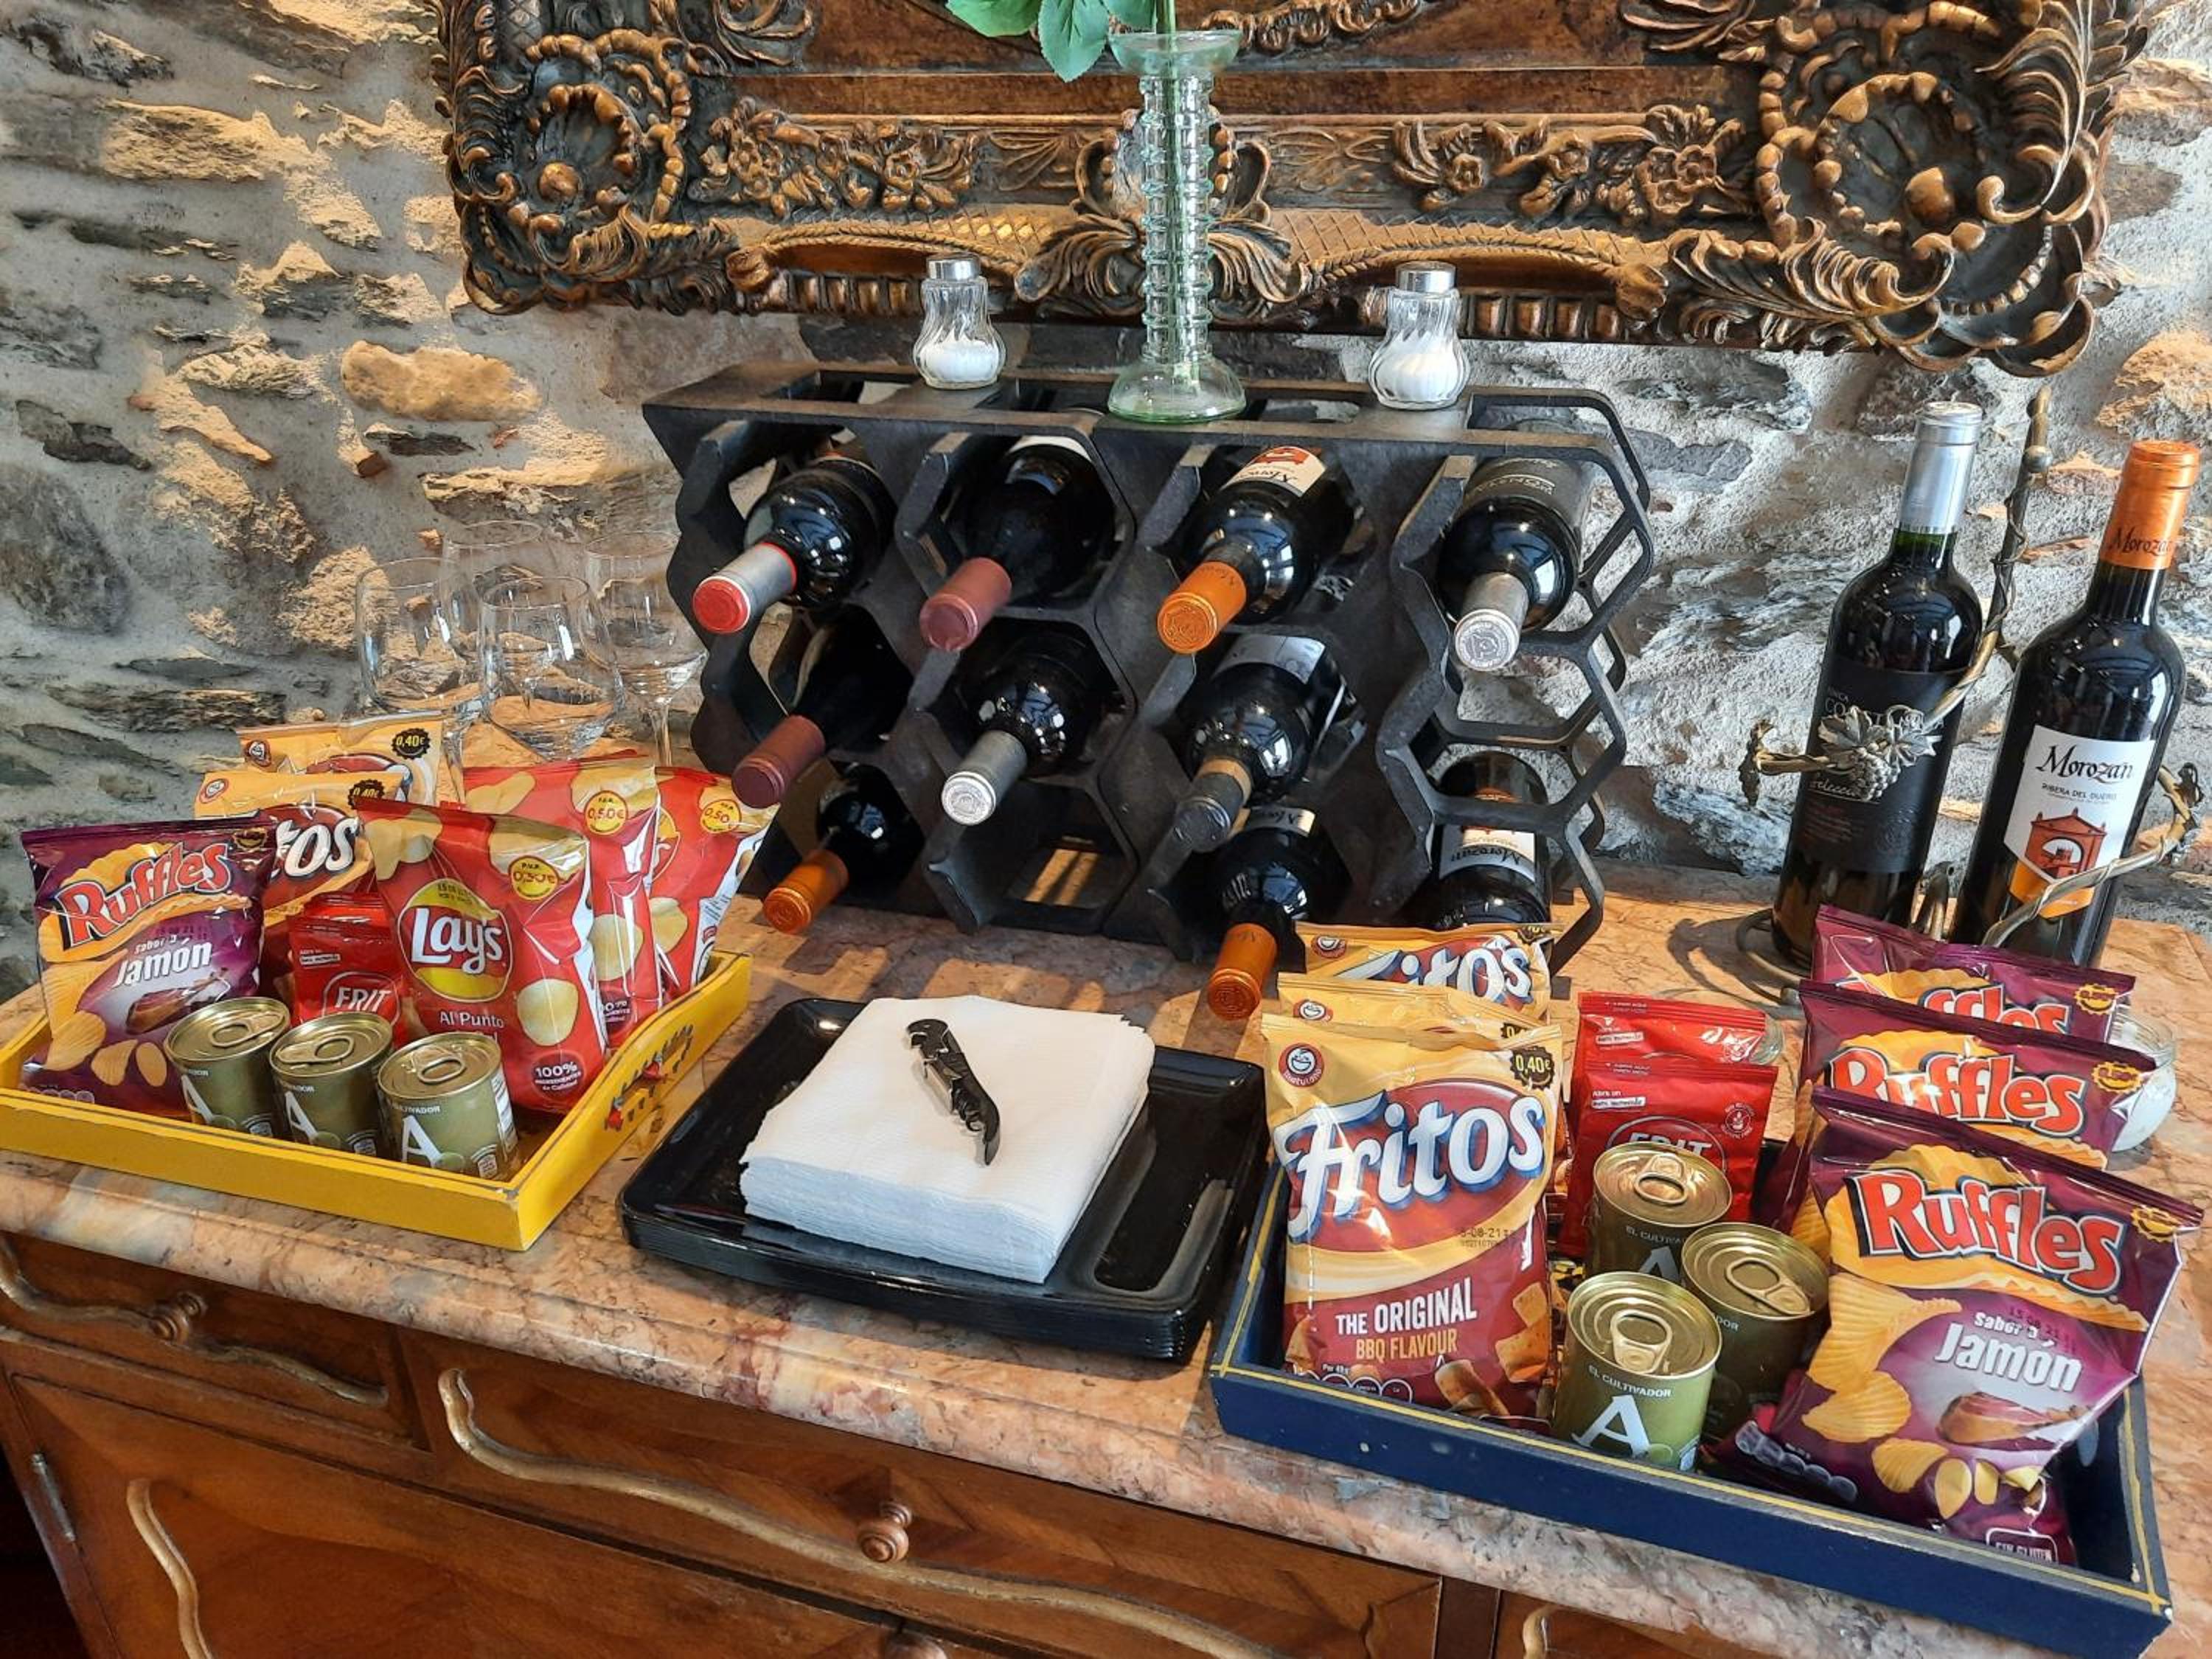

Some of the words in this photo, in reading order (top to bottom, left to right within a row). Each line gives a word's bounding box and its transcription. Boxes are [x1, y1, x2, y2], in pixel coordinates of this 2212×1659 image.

[395, 735, 425, 748] 0,40€
[2035, 745, 2133, 785] Morozan
[2072, 790, 2086, 798] DEL
[1451, 847, 1520, 866] Morozan
[53, 841, 232, 949] Ruffles
[411, 907, 503, 974] Lay's
[112, 937, 212, 988] Jamón
[335, 987, 392, 1012] FRIT
[439, 1010, 453, 1024] Al
[459, 1012, 504, 1029] Punto
[535, 1062, 577, 1077] 100%
[1515, 1054, 1551, 1075] 0,40€
[1831, 1048, 2086, 1136] Ruffles
[285, 1091, 319, 1143] A
[401, 1115, 442, 1168] A
[1273, 1090, 1546, 1244] Fritos
[1641, 1232, 1681, 1245] CULTIVA
[1854, 1168, 2125, 1294] Ruffles
[1335, 1313, 1368, 1335] THE
[1374, 1276, 1478, 1334] ORIGINAL
[1974, 1311, 2023, 1335] sabor
[1355, 1338, 1386, 1363] BBQ
[1390, 1328, 1458, 1360] FLAVOUR
[1934, 1321, 2083, 1392] Jamón
[1588, 1364, 1600, 1379] EL
[1602, 1374, 1672, 1397] CULTIVADOR
[1571, 1394, 1652, 1458] A
